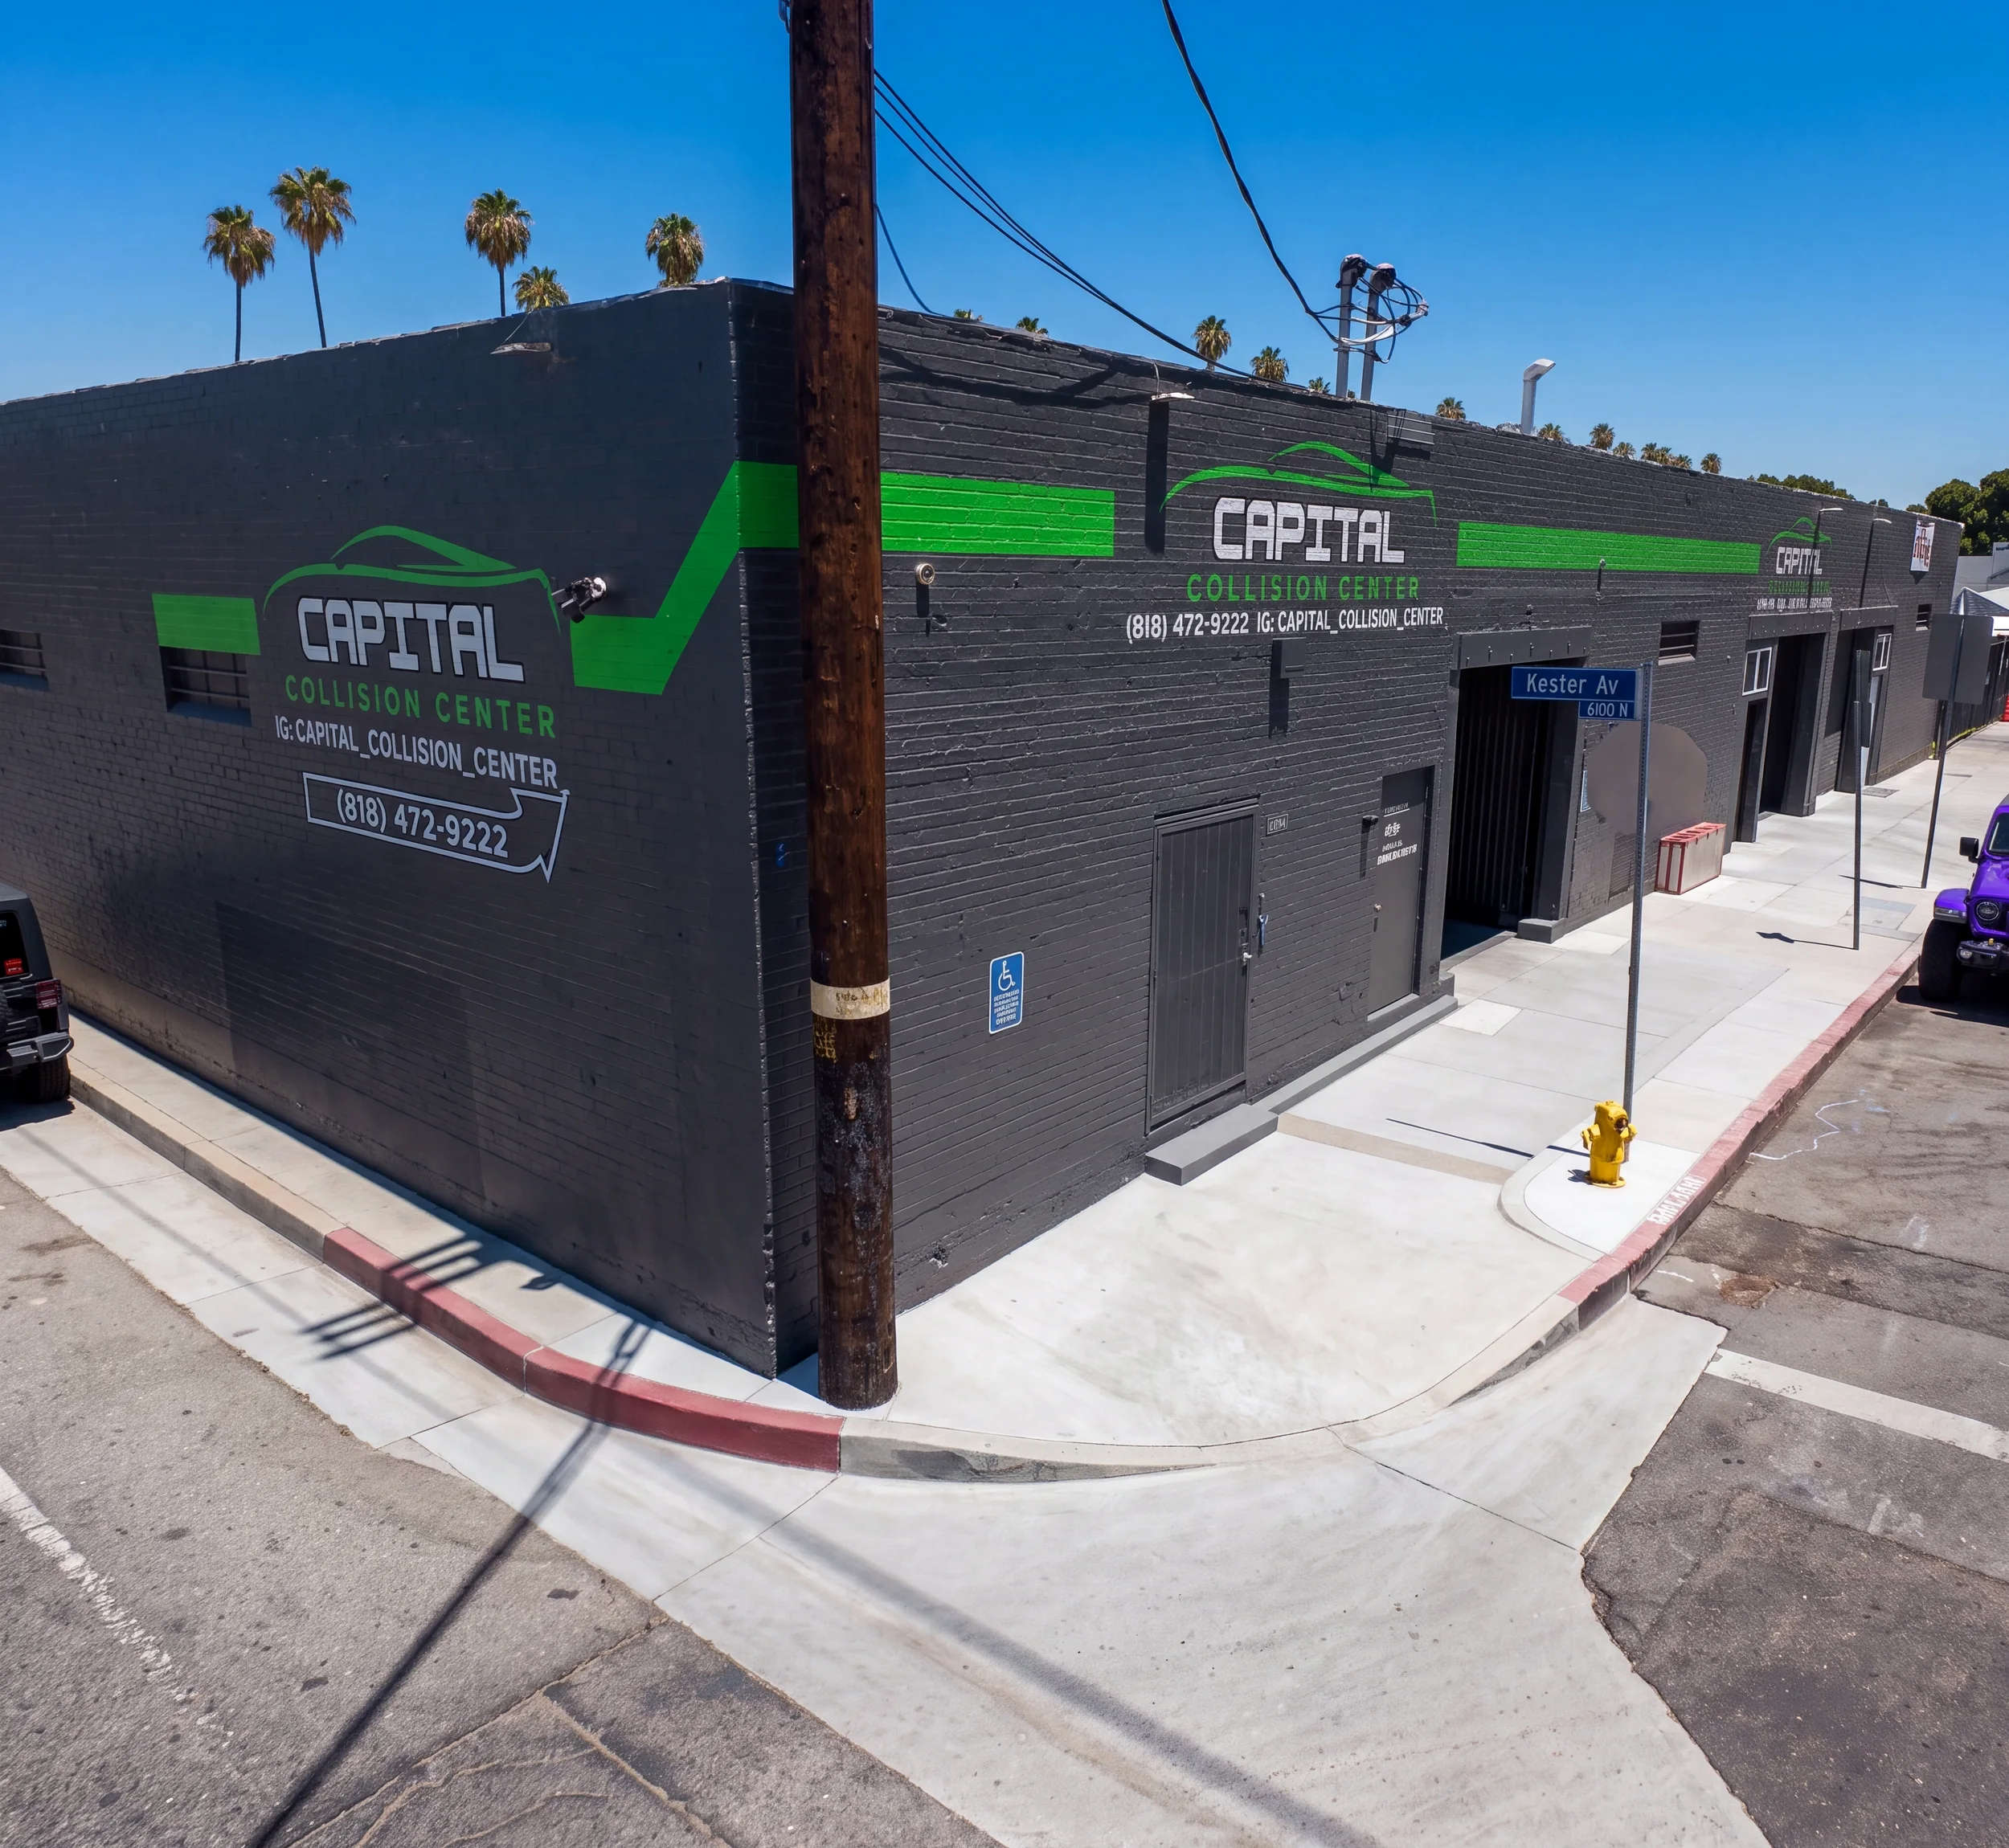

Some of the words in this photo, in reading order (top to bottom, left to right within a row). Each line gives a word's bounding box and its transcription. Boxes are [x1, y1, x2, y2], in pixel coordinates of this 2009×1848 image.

[1213, 497, 1405, 563] CAPITAL
[1187, 573, 1328, 603] COLLISION
[1339, 576, 1419, 600] CENTER
[297, 597, 525, 682] CAPITAL
[1126, 614, 1168, 644] (818)
[1172, 611, 1250, 637] 472-9222
[1257, 611, 1275, 633] IG:
[1277, 607, 1444, 635] CAPITAL_COLLISION_CENTER
[285, 674, 421, 718] COLLISION
[435, 692, 556, 738] CENTER
[1527, 673, 1586, 694] Kester
[1596, 675, 1619, 695] Av
[1587, 702, 1615, 718] 6100
[1619, 703, 1628, 718] N
[275, 714, 294, 742] IG:
[295, 718, 558, 789] CAPITAL_COLLISION_CENTER
[337, 787, 387, 833] (818)
[394, 803, 509, 859] 472-9222
